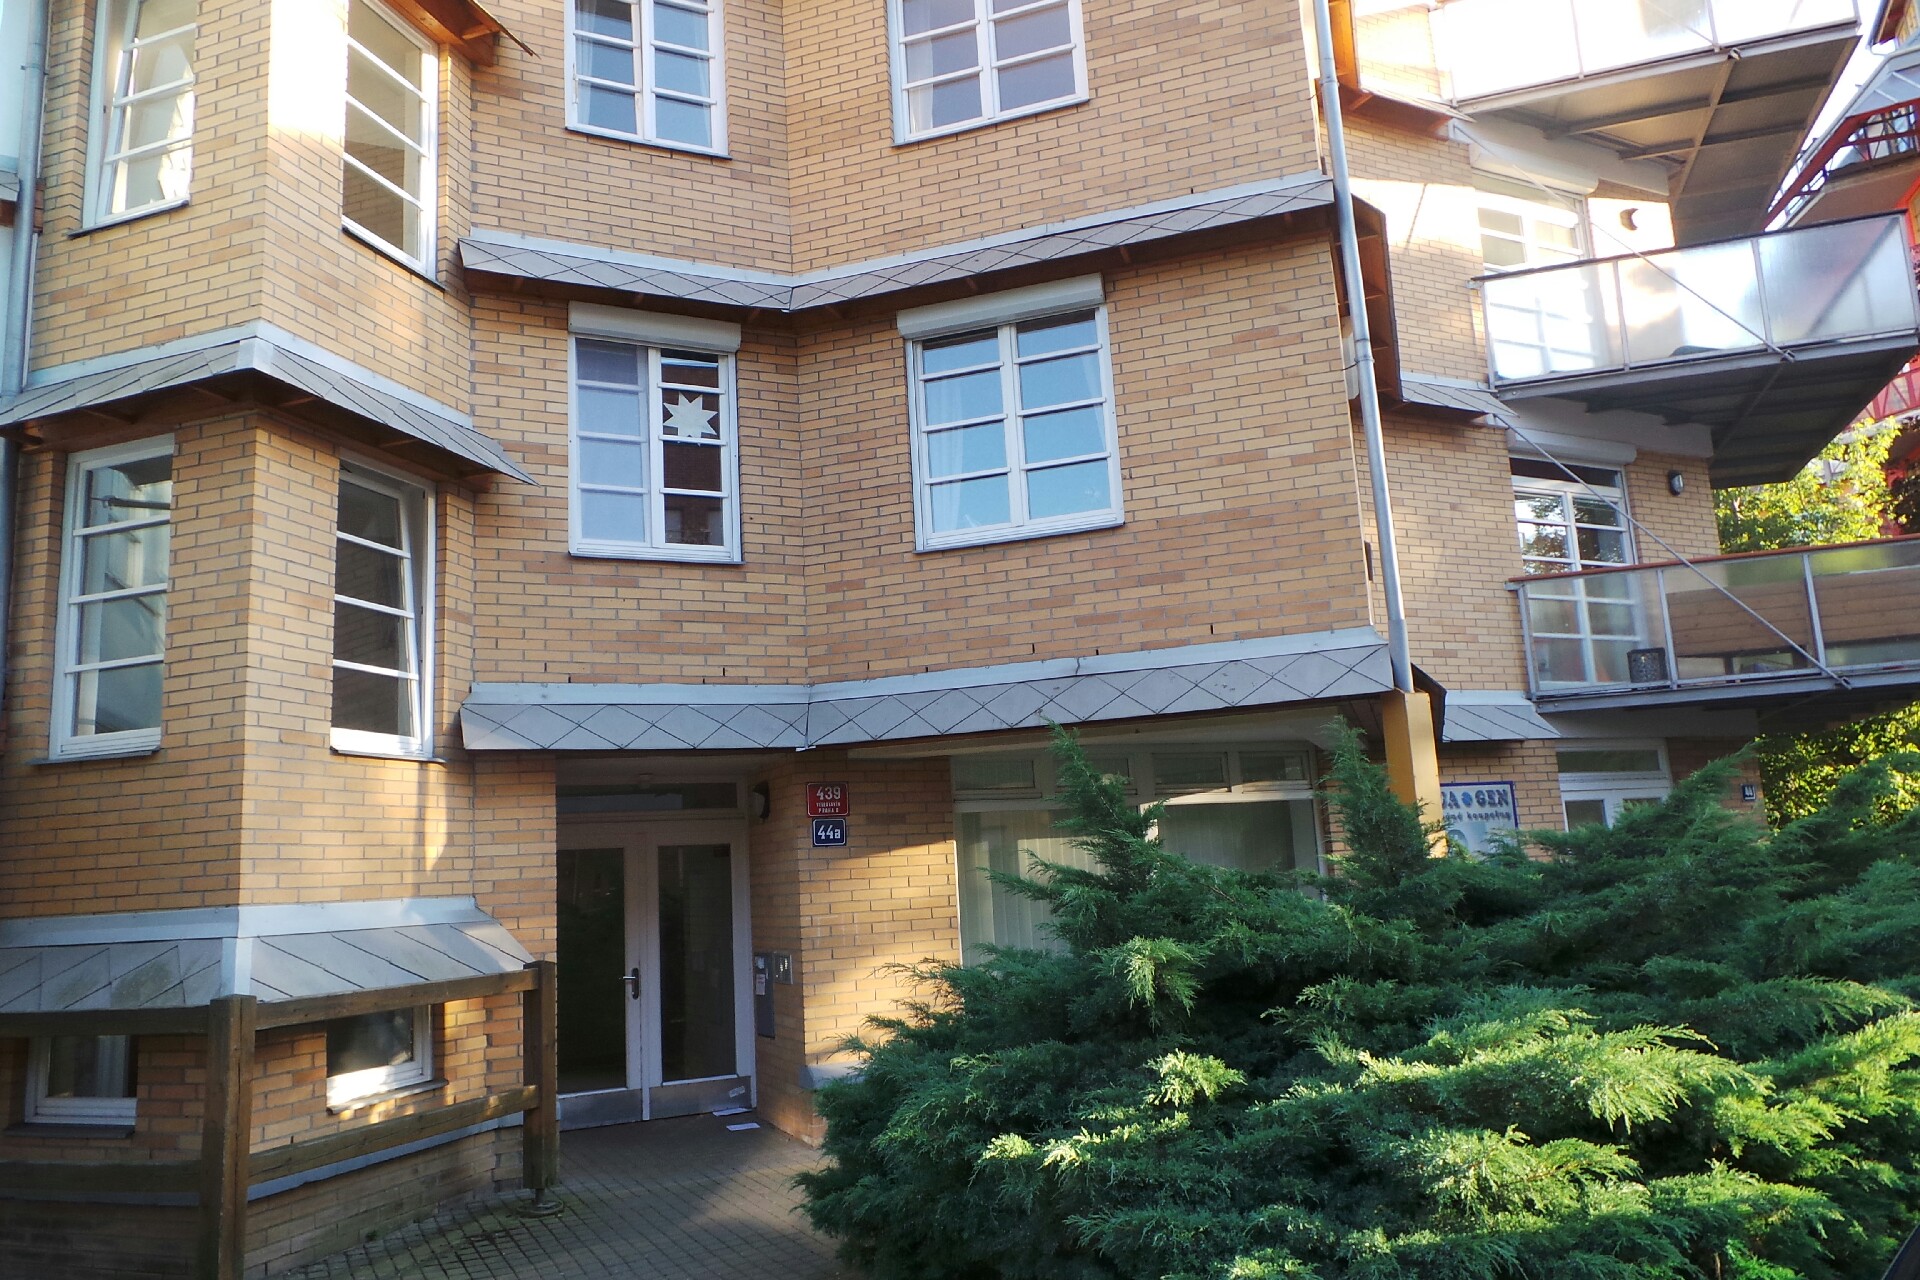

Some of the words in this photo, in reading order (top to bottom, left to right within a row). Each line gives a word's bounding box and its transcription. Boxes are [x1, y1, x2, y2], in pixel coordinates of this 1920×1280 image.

[816, 787, 841, 800] 439
[1475, 789, 1509, 808] GEN
[817, 825, 841, 840] 44a
